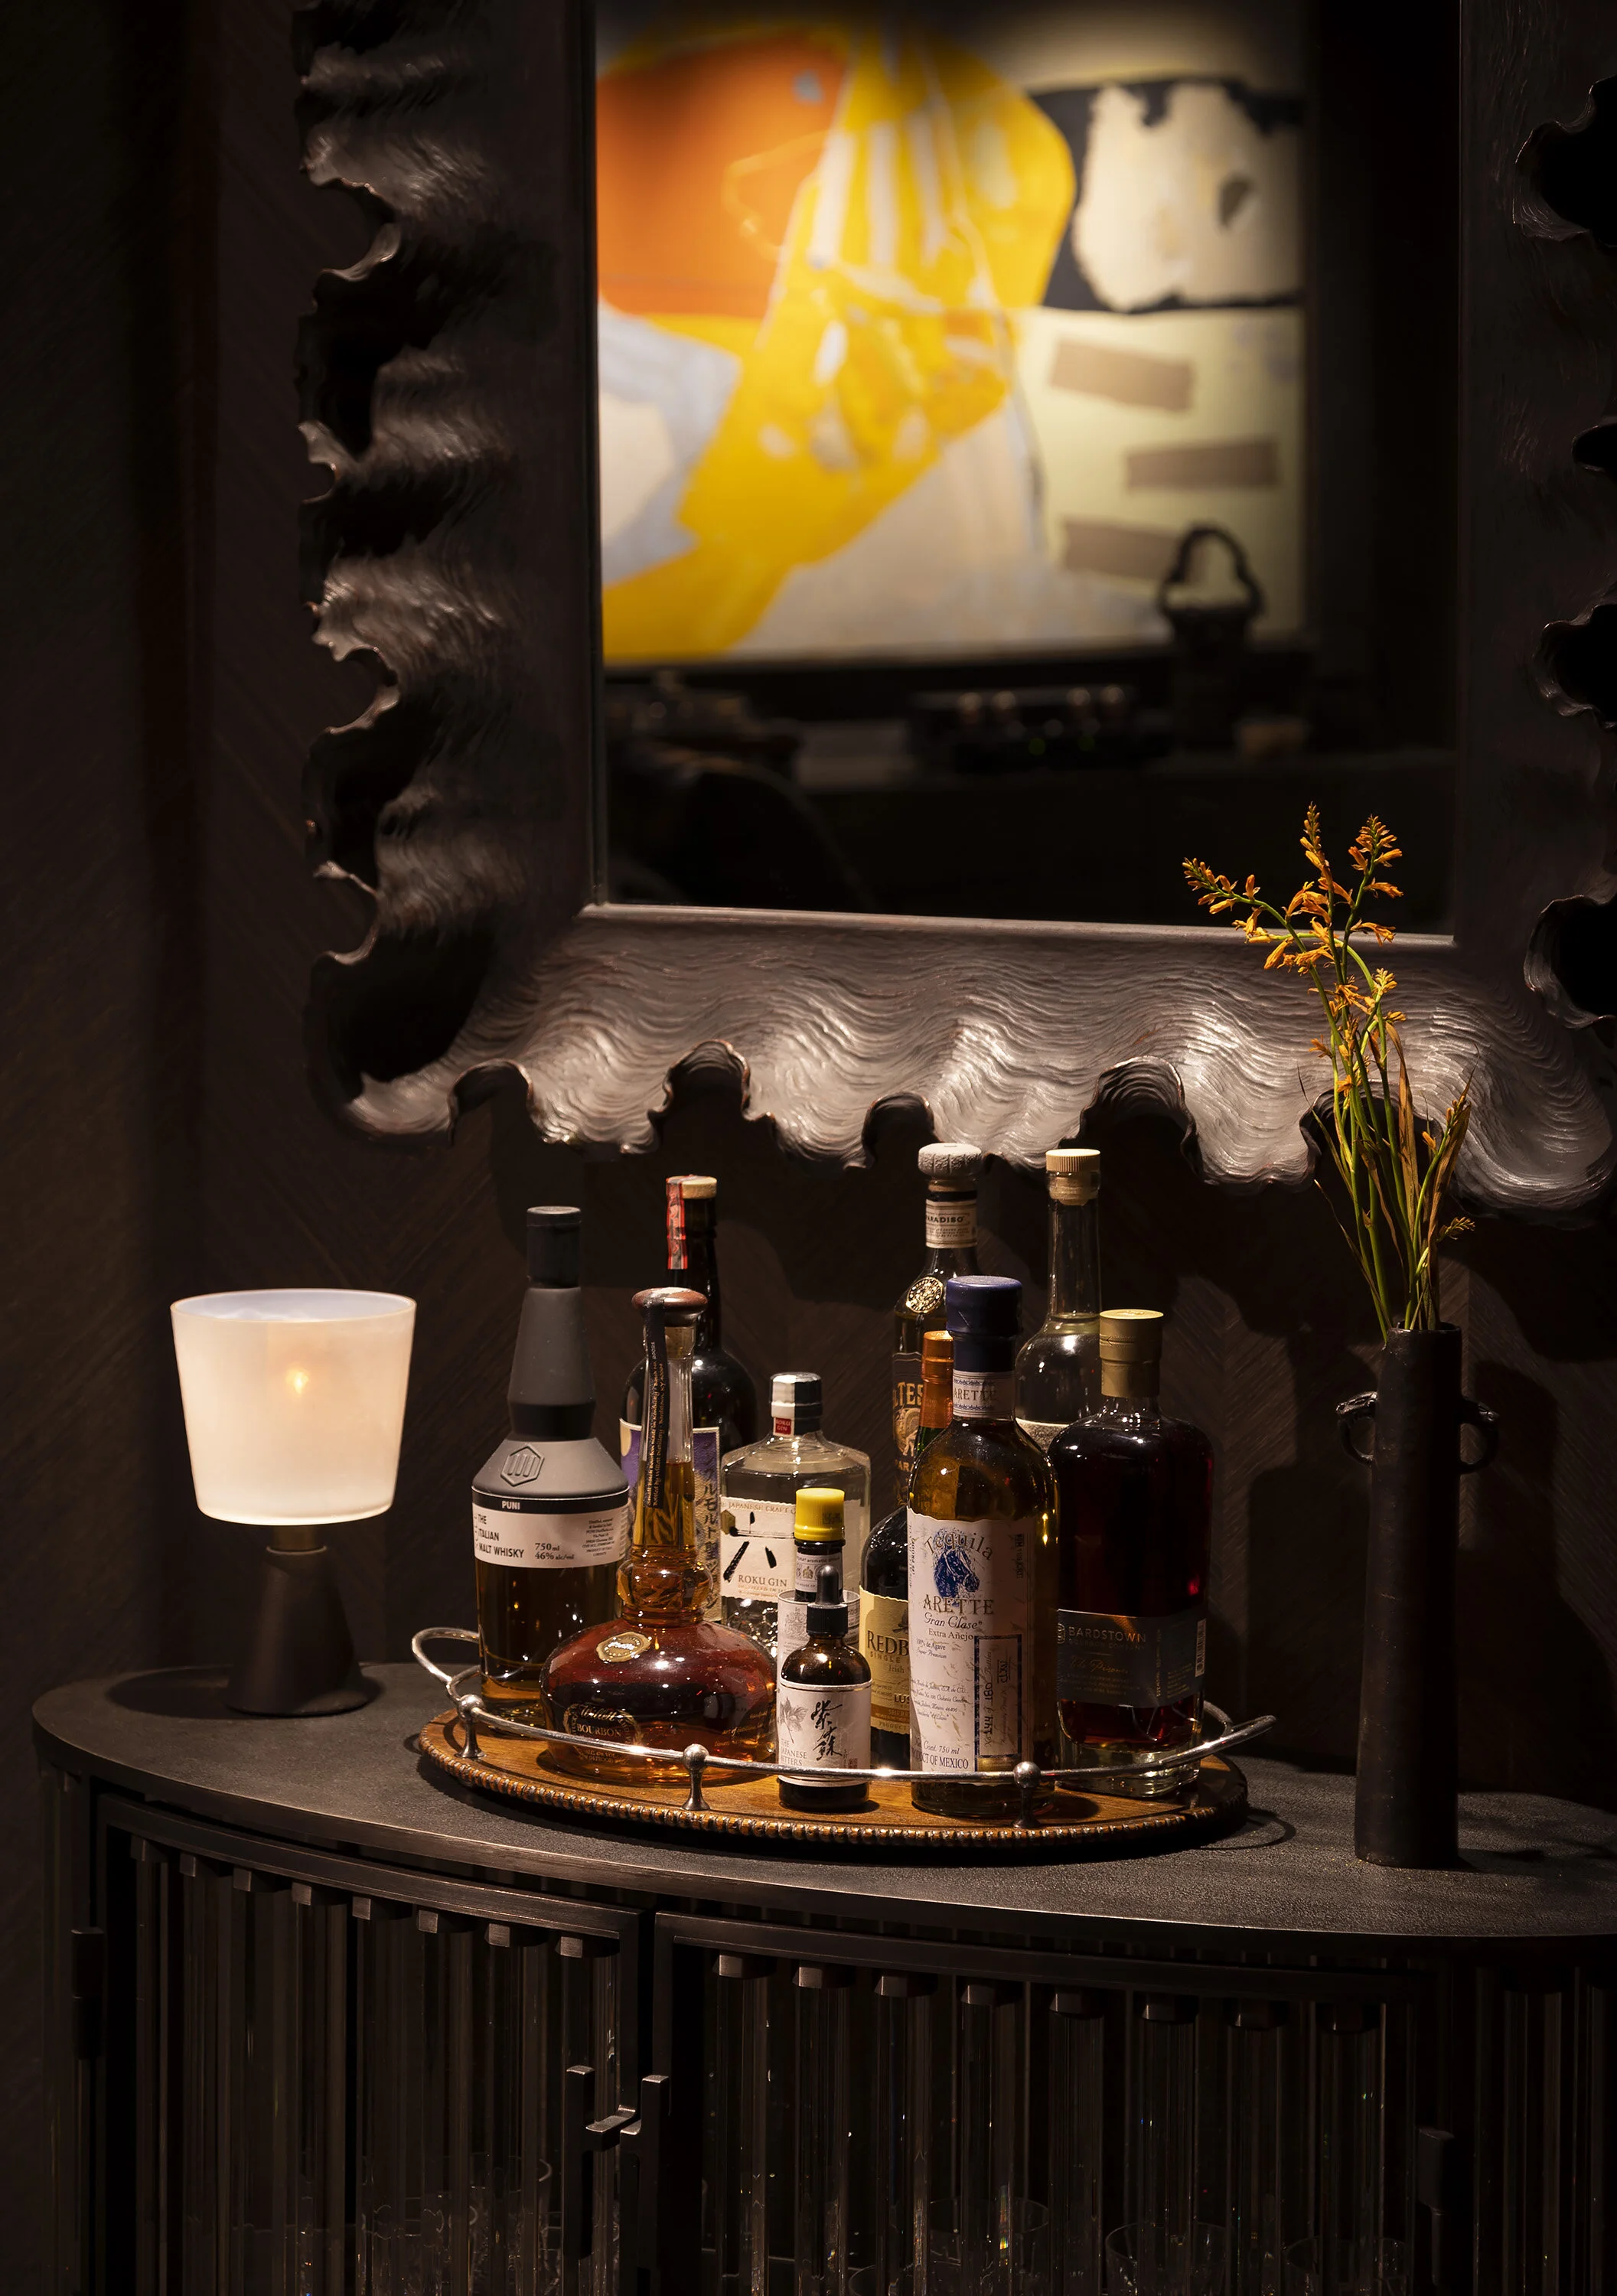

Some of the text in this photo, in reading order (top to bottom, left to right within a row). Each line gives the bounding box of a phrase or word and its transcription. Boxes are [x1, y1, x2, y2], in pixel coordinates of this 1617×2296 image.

[926, 1215, 963, 1223] ARADISO
[954, 1388, 996, 1401] ARETTE
[501, 1501, 520, 1510] PUNI
[728, 1502, 764, 1511] JAPANESE
[478, 1514, 487, 1525] THE
[478, 1528, 499, 1541] ITALIAN
[479, 1542, 524, 1558] MALT WHISKY
[924, 1532, 993, 1561] Tequila
[738, 1575, 787, 1587] ROKU GIN
[923, 1594, 993, 1615] ARETTE
[924, 1612, 945, 1627] Gran
[928, 1628, 974, 1641] Extra Añejo
[1068, 1626, 1146, 1642] BARDSTOWN
[869, 1651, 900, 1664] SINGLE
[888, 1664, 905, 1674] Irish
[983, 1682, 993, 1701] 180
[894, 1694, 910, 1704] LUS
[577, 1724, 621, 1737] BOURBON
[781, 1738, 790, 1747] THE
[781, 1746, 807, 1759] JAPANESE
[781, 1755, 803, 1766] BITTERS
[930, 1754, 938, 1766] OF
[939, 1756, 969, 1769] MEXICO
